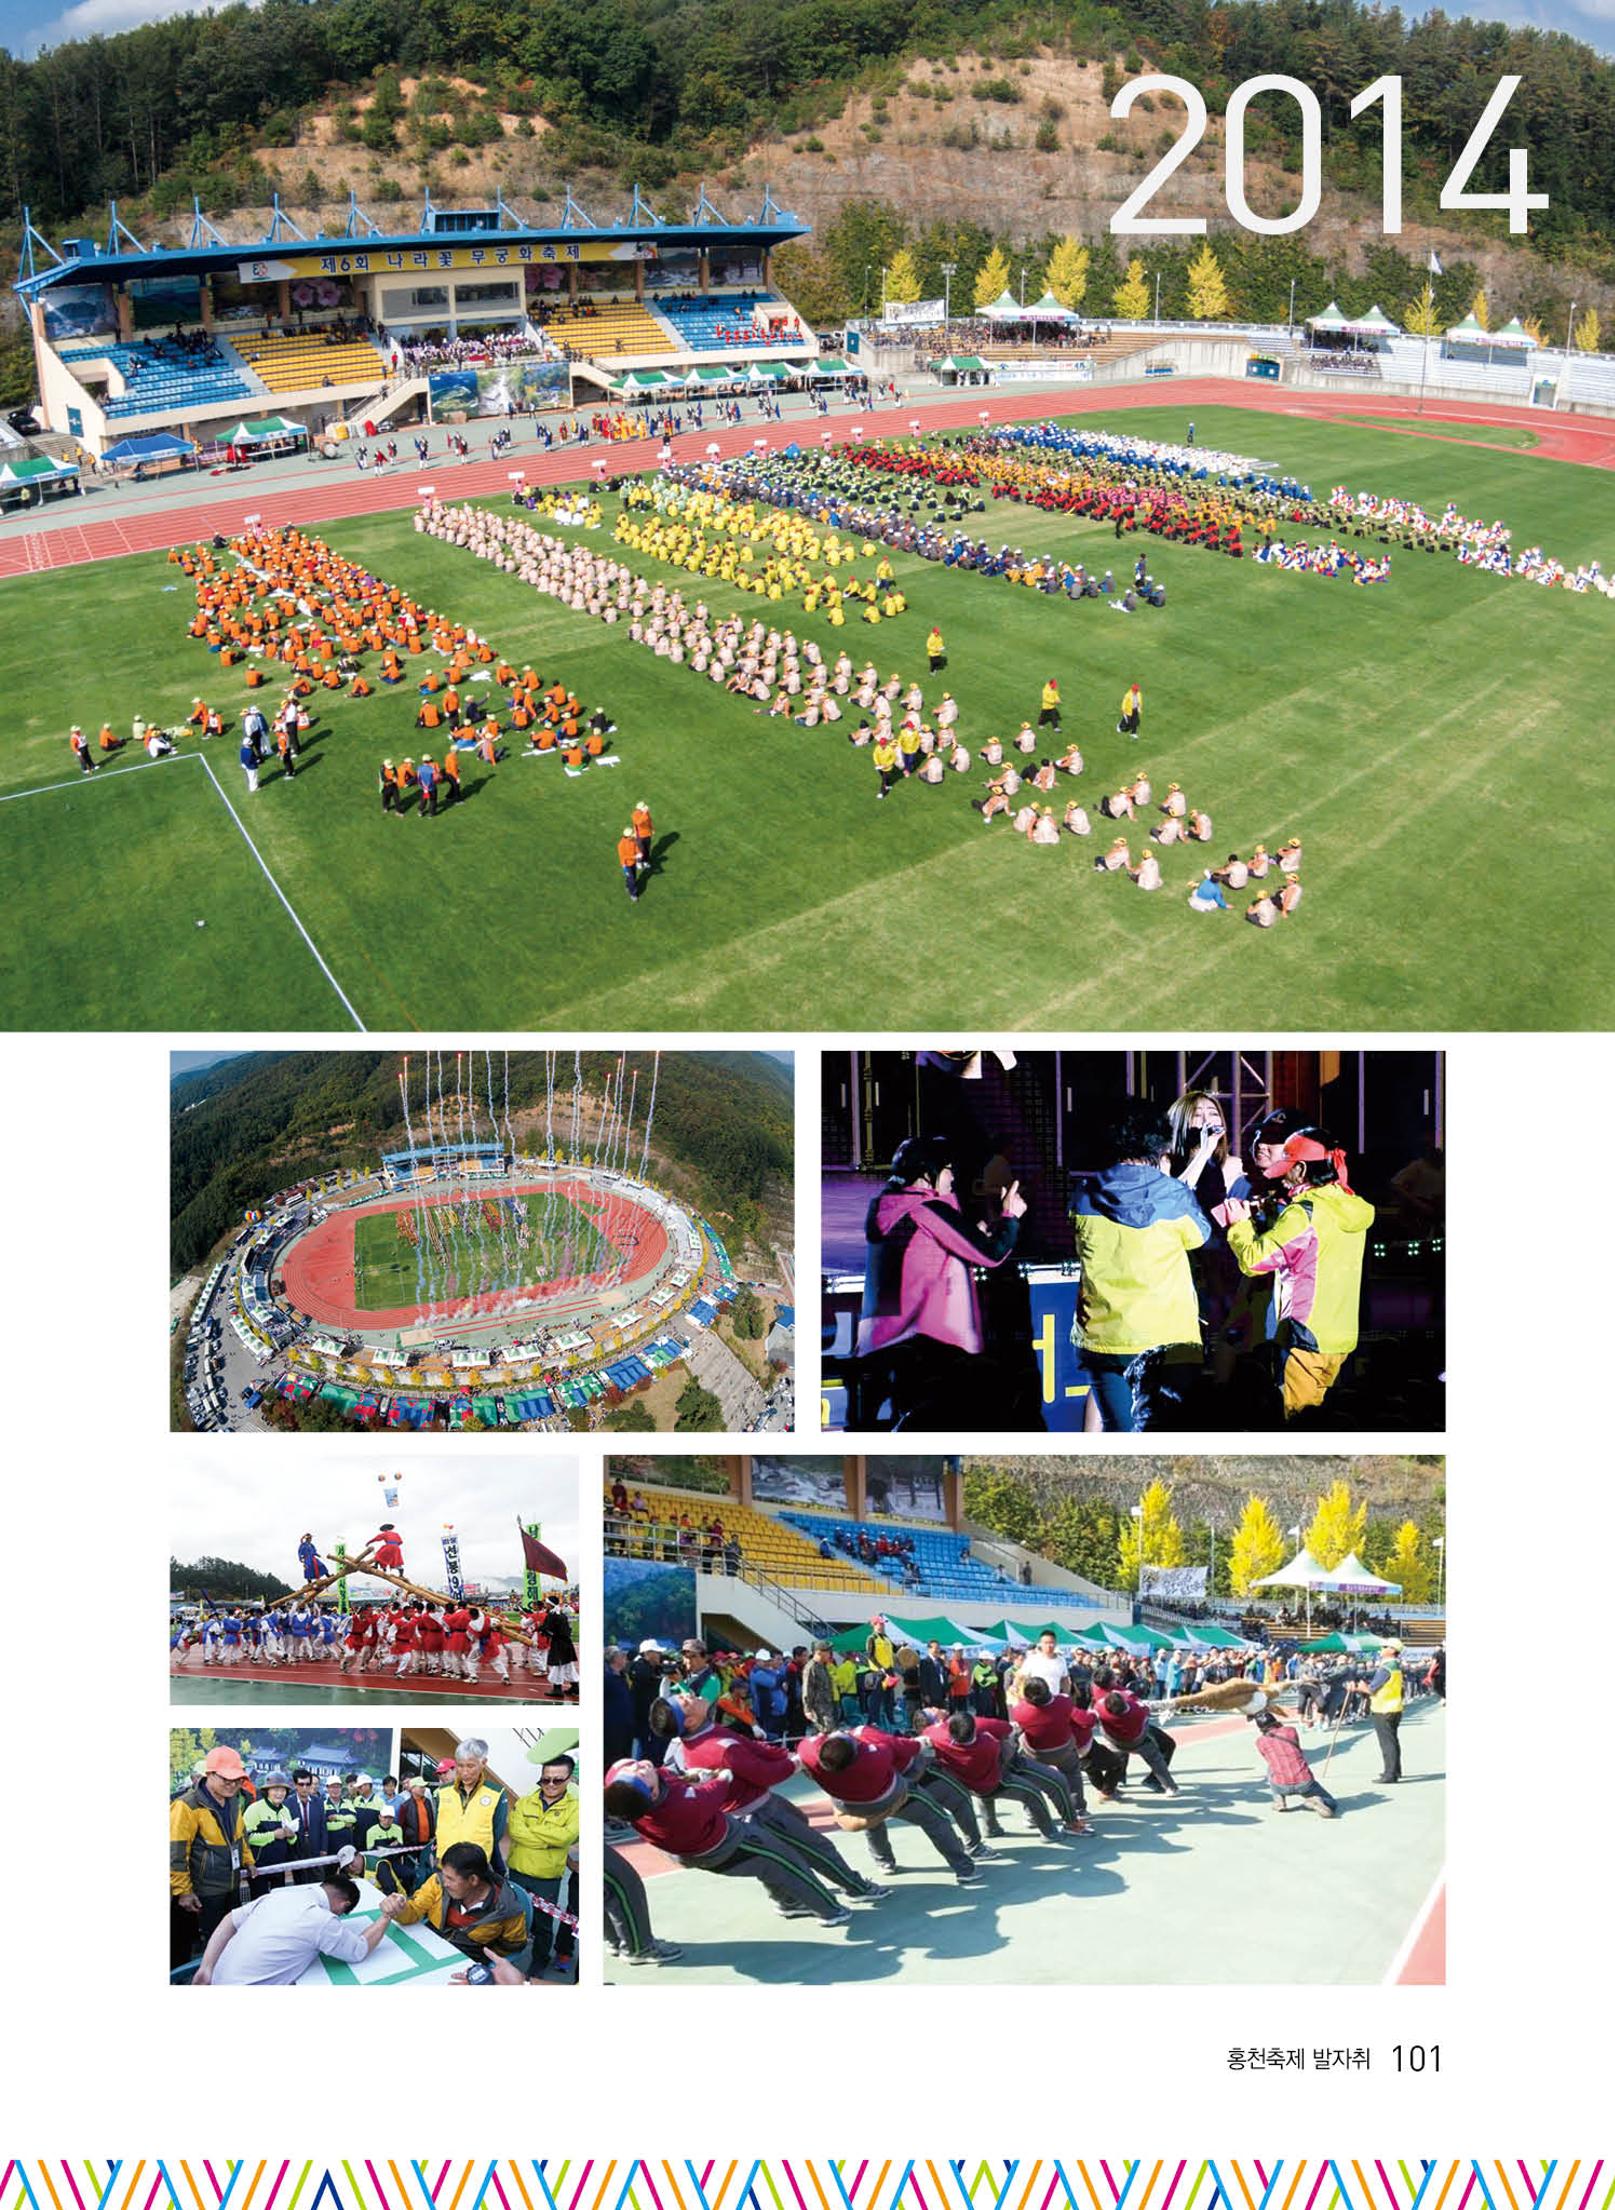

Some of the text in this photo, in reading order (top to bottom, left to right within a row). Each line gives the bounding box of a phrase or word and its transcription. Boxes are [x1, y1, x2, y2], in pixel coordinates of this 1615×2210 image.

[321, 243, 581, 274] 제6회 나라꽃 무궁화축제
